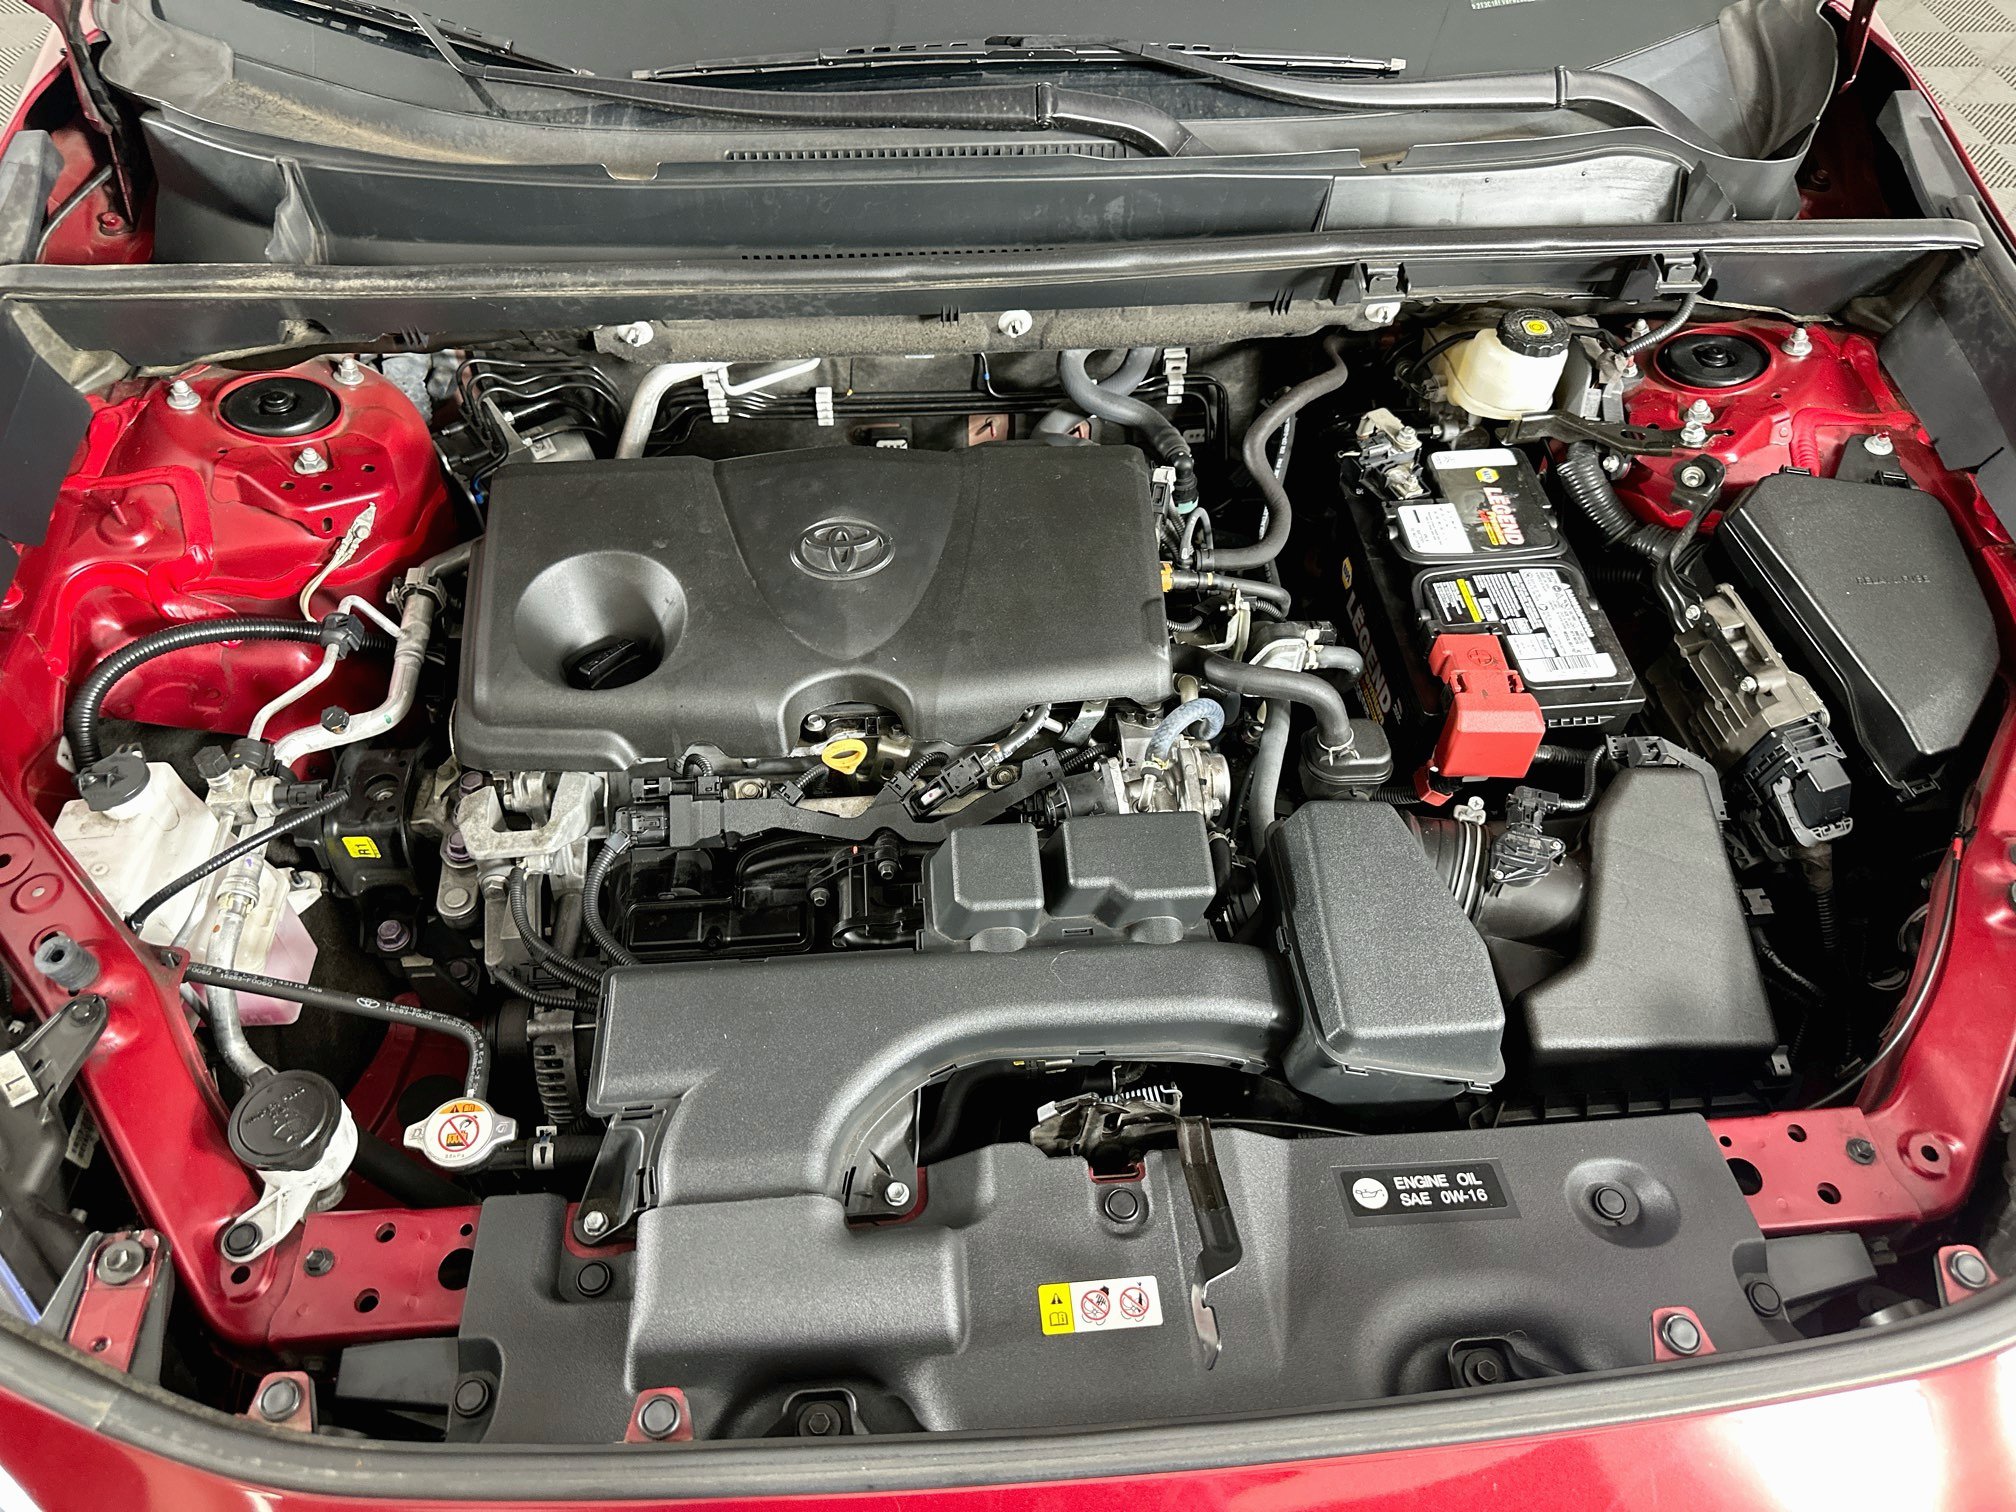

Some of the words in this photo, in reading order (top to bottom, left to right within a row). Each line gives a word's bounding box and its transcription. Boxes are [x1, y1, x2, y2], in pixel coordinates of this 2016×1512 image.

[1855, 576, 1891, 585] RELAY
[1901, 575, 1931, 584] FUSE
[1484, 604, 1492, 614] Pb
[1346, 589, 1391, 714] LEGEND
[354, 843, 372, 855] R1
[5, 1075, 26, 1091] L
[1393, 1174, 1449, 1190] ENGINE
[1456, 1172, 1483, 1187] OIL
[1400, 1192, 1433, 1207] SAE
[1440, 1188, 1488, 1204] 0W-16
